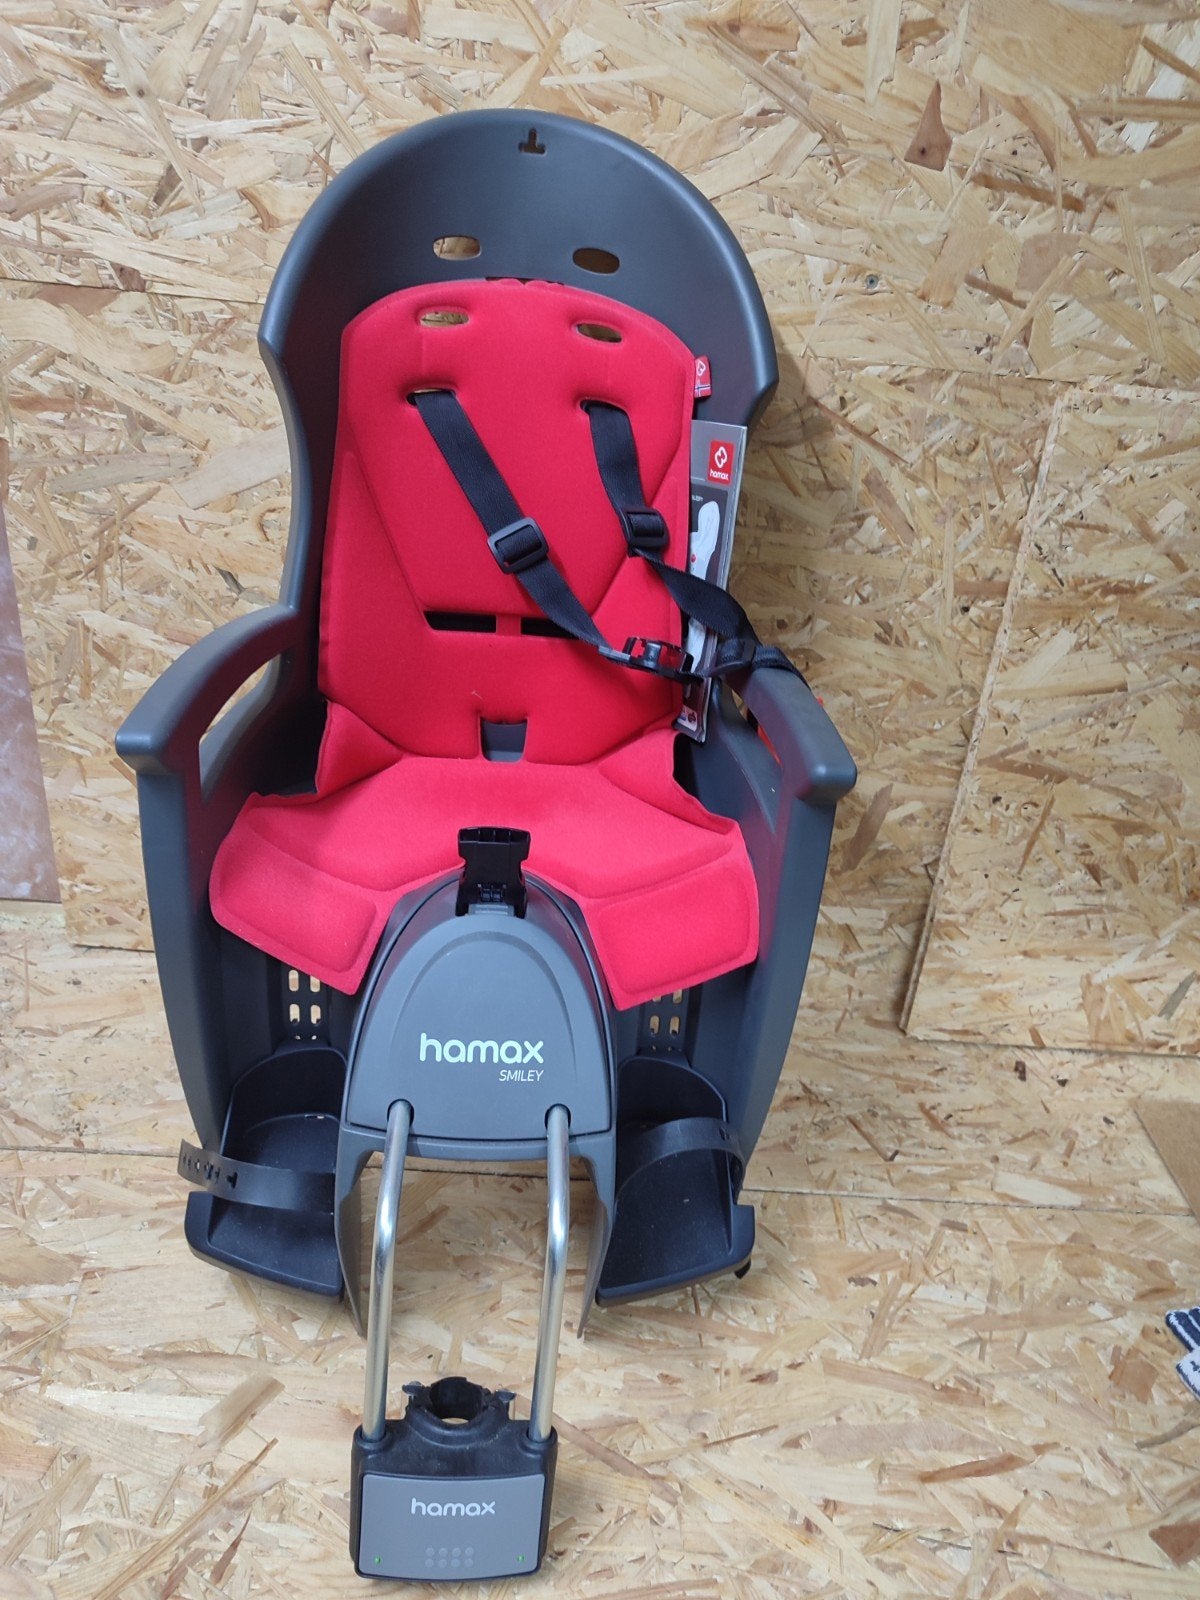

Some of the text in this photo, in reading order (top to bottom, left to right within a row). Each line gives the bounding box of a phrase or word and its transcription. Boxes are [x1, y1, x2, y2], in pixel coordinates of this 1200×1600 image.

[419, 1032, 544, 1064] hamax
[498, 1069, 544, 1082] SMILEY
[410, 1497, 496, 1516] hamax
